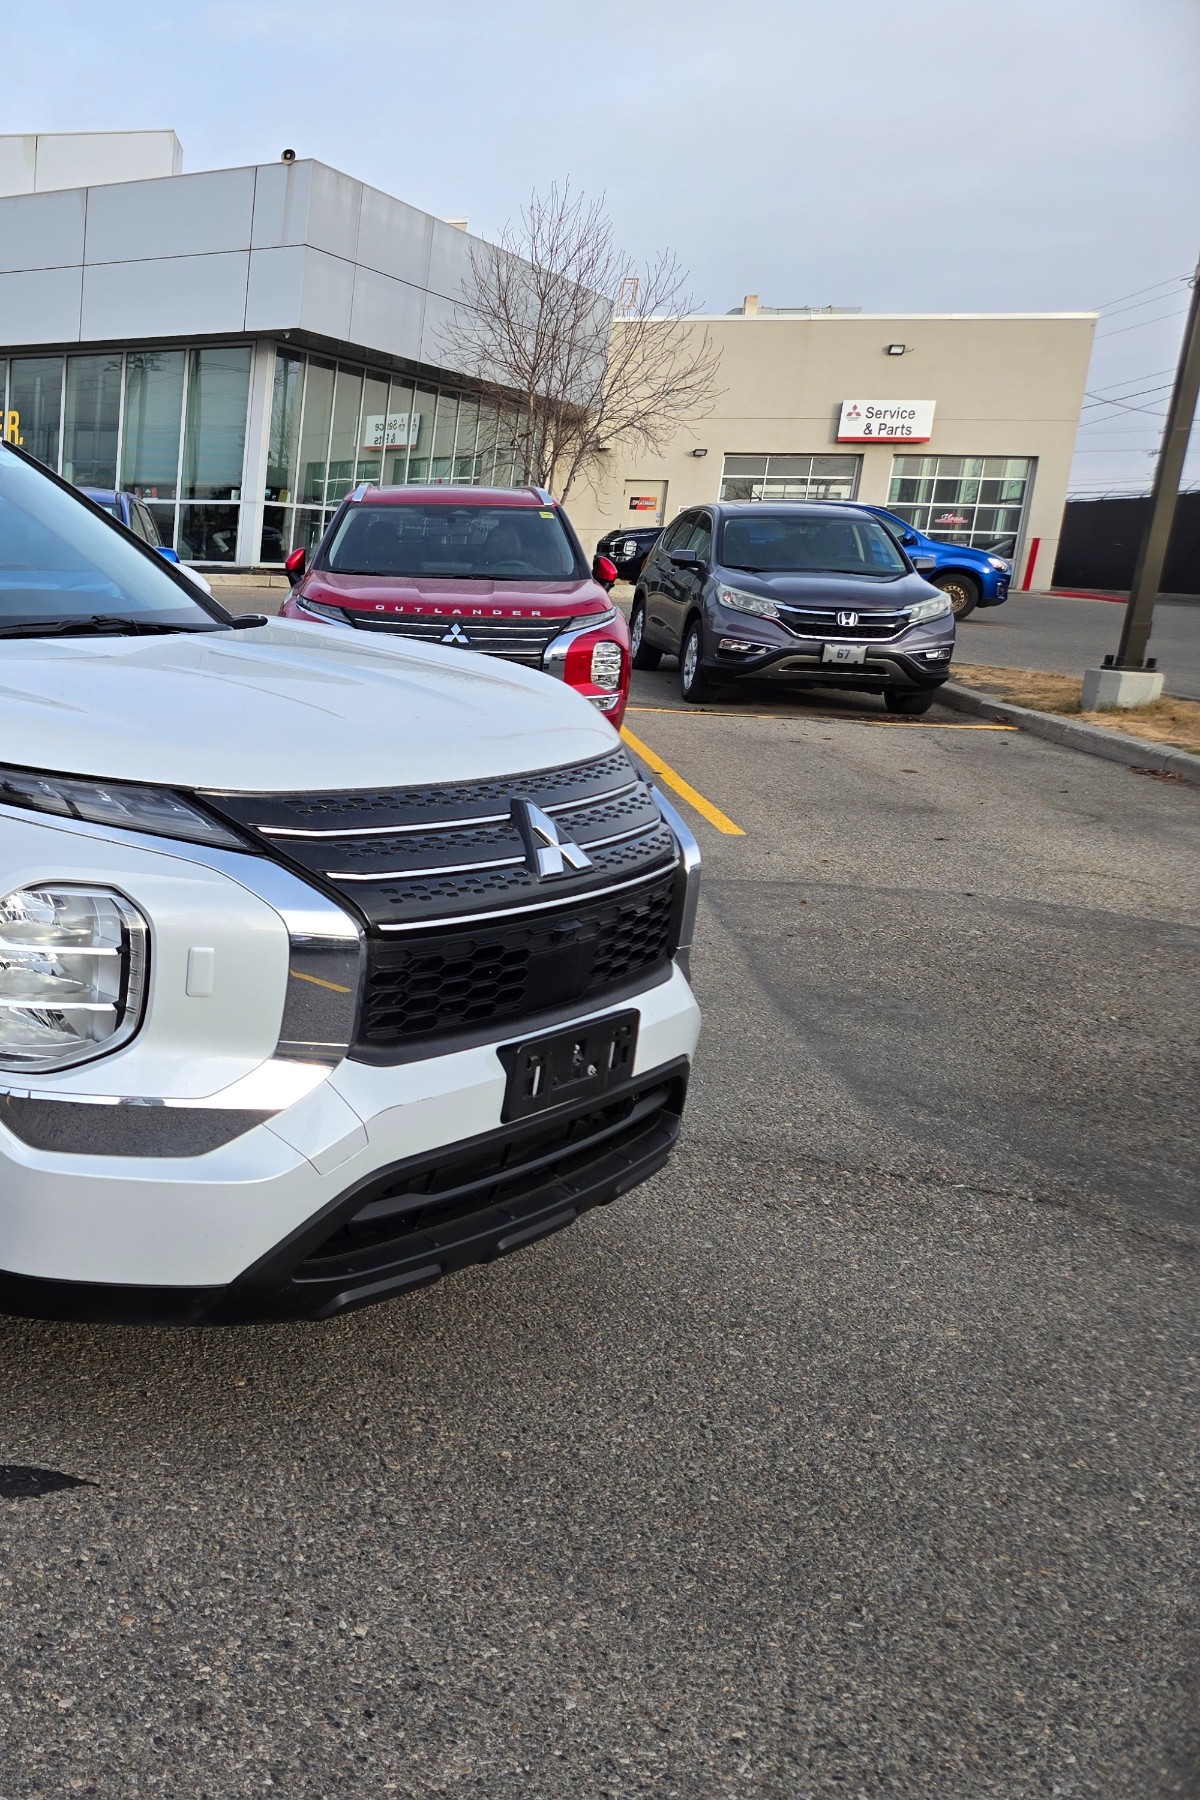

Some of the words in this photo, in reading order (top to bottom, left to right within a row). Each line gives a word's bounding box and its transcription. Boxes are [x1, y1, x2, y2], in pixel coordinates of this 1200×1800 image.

[865, 406, 916, 420] Service
[863, 422, 873, 436] &
[878, 423, 912, 436] Parts
[375, 604, 541, 617] OUTLANDER
[836, 649, 851, 660] 67
